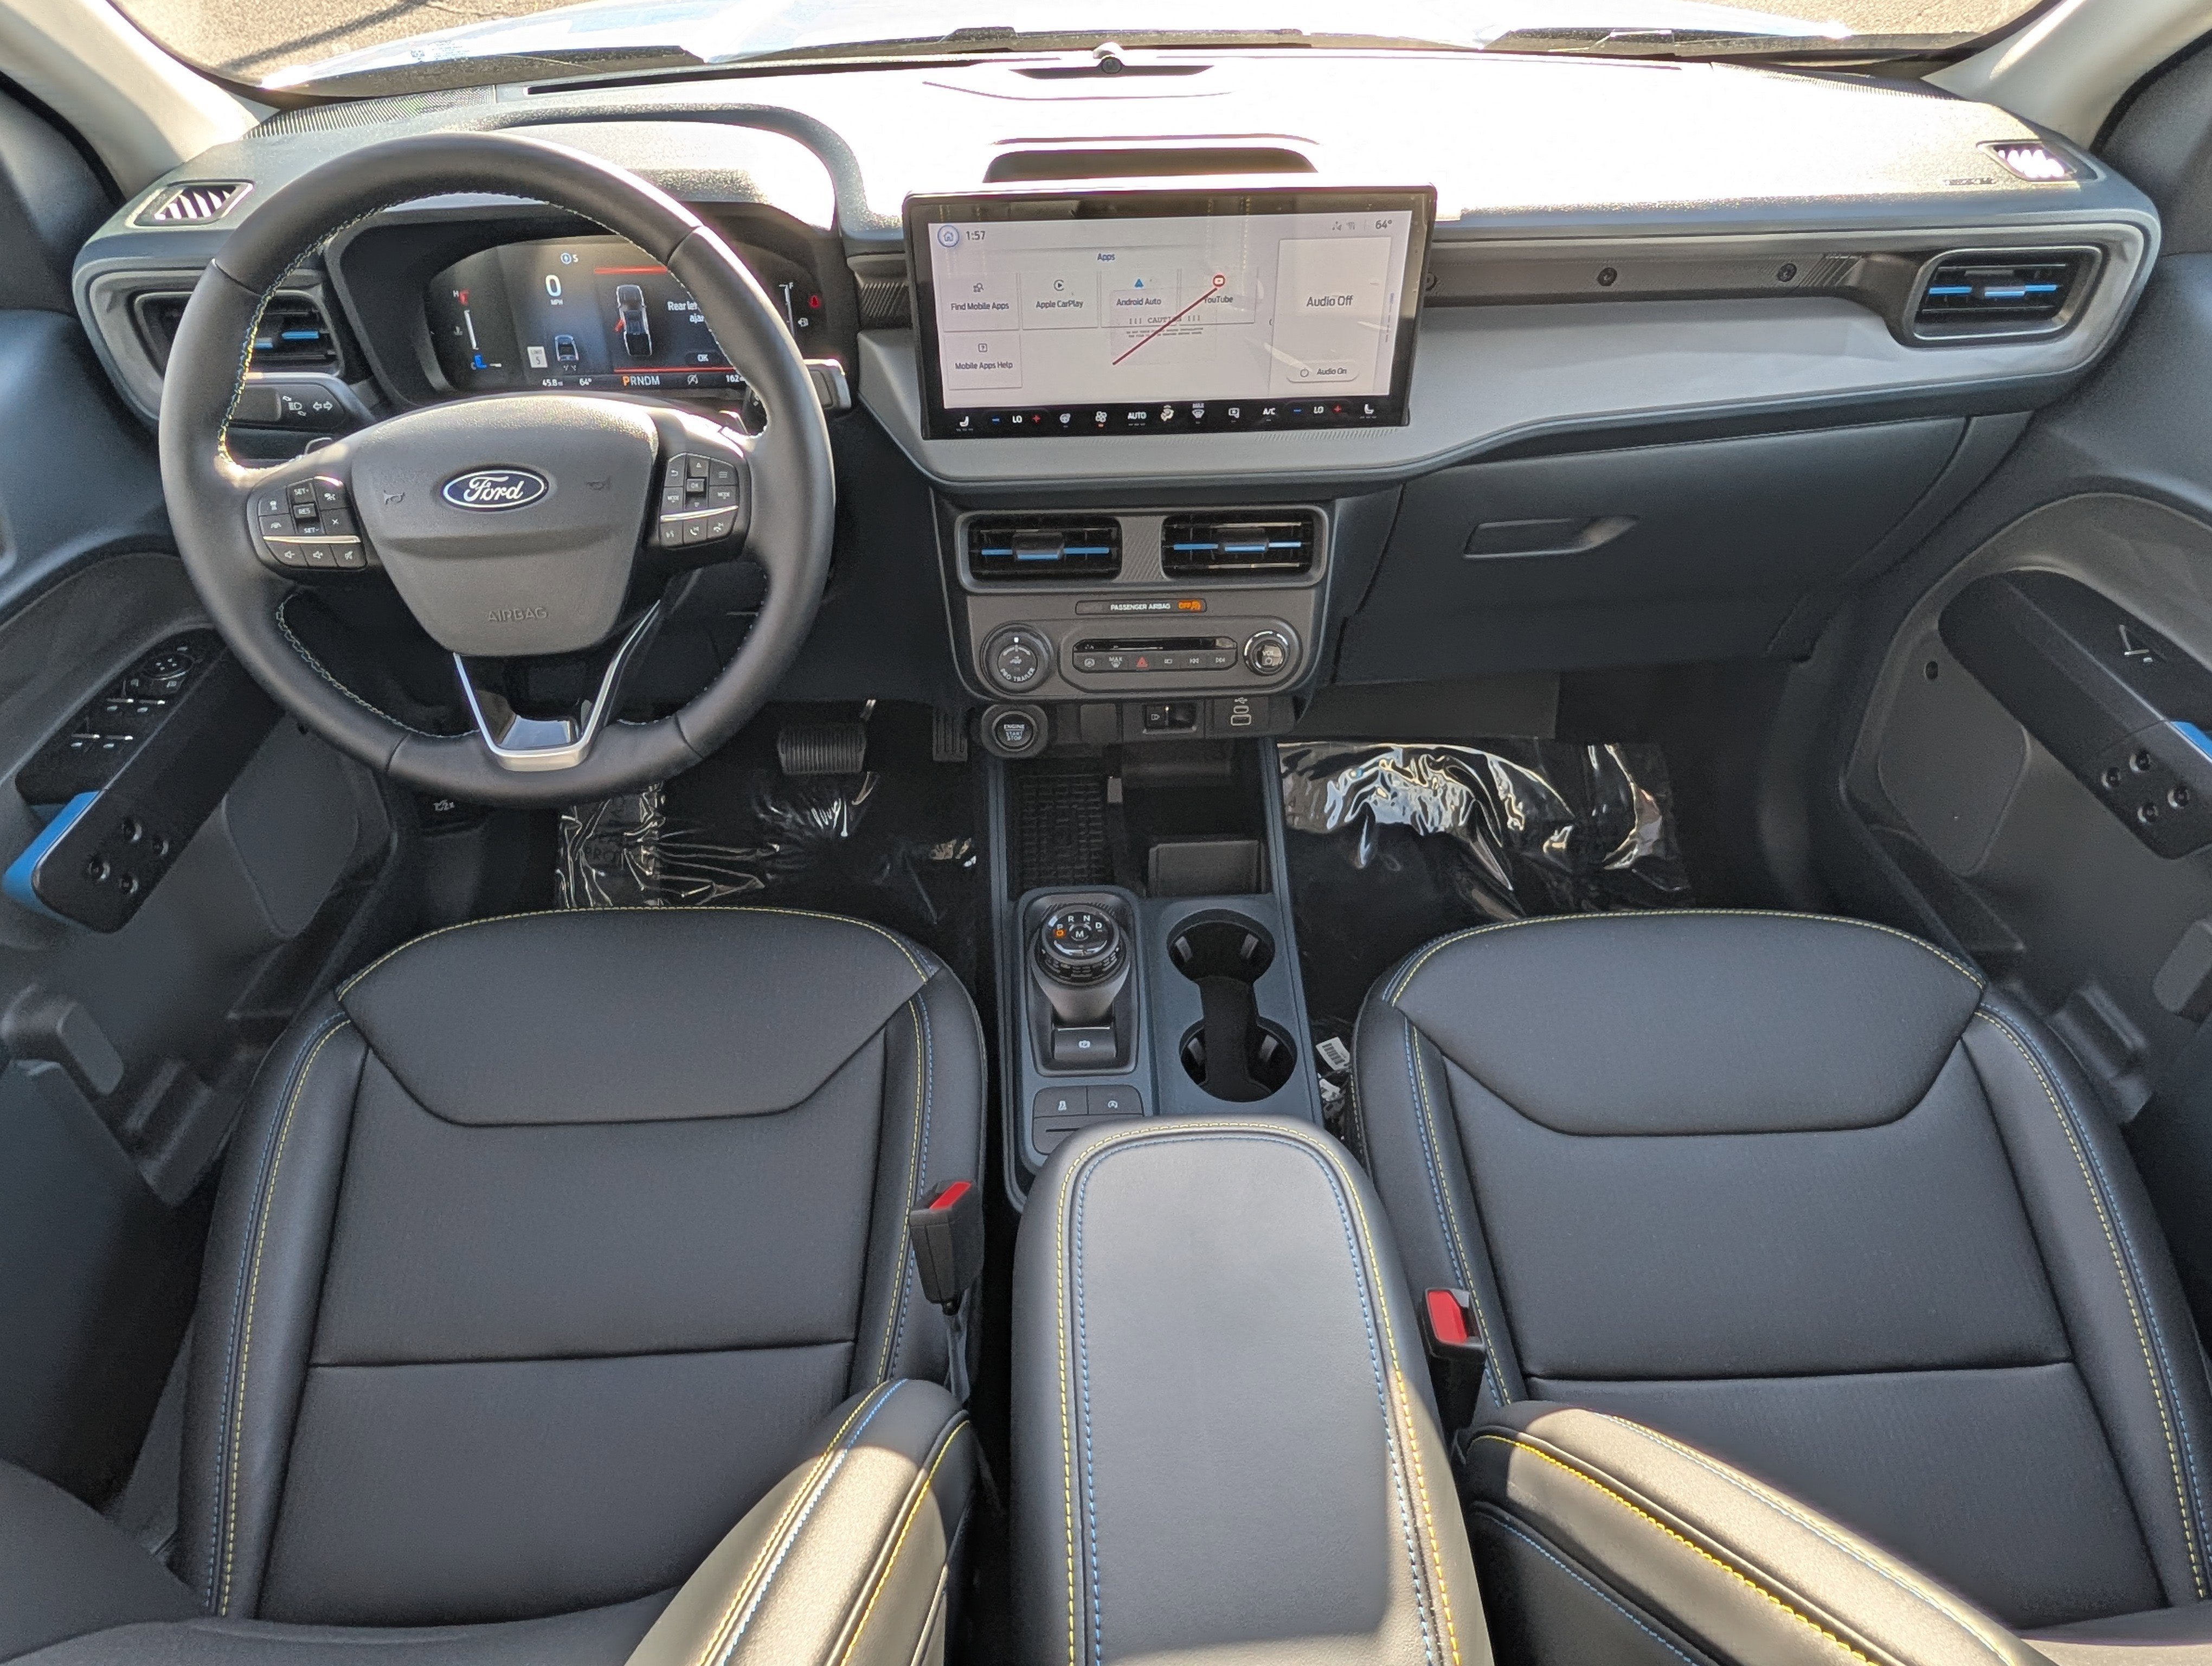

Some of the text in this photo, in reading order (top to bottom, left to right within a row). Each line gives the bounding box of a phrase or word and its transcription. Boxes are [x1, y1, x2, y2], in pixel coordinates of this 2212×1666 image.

[966, 230, 986, 240] 1:57
[1097, 253, 1115, 261] Apps
[545, 274, 562, 297] 0
[1036, 300, 1083, 309] Apple CarPlay
[1116, 298, 1143, 306] Android
[1307, 295, 1353, 306] Audio Off
[667, 301, 686, 311] Rear
[951, 303, 966, 311] Find
[992, 302, 1009, 310] Apps
[979, 362, 995, 370] Apps
[997, 361, 1013, 369] Help
[1314, 406, 1324, 414] LO
[1012, 415, 1023, 424] LO
[1128, 412, 1147, 420] AUTO
[464, 476, 524, 502] Ford
[488, 607, 548, 622] AIRBAG
